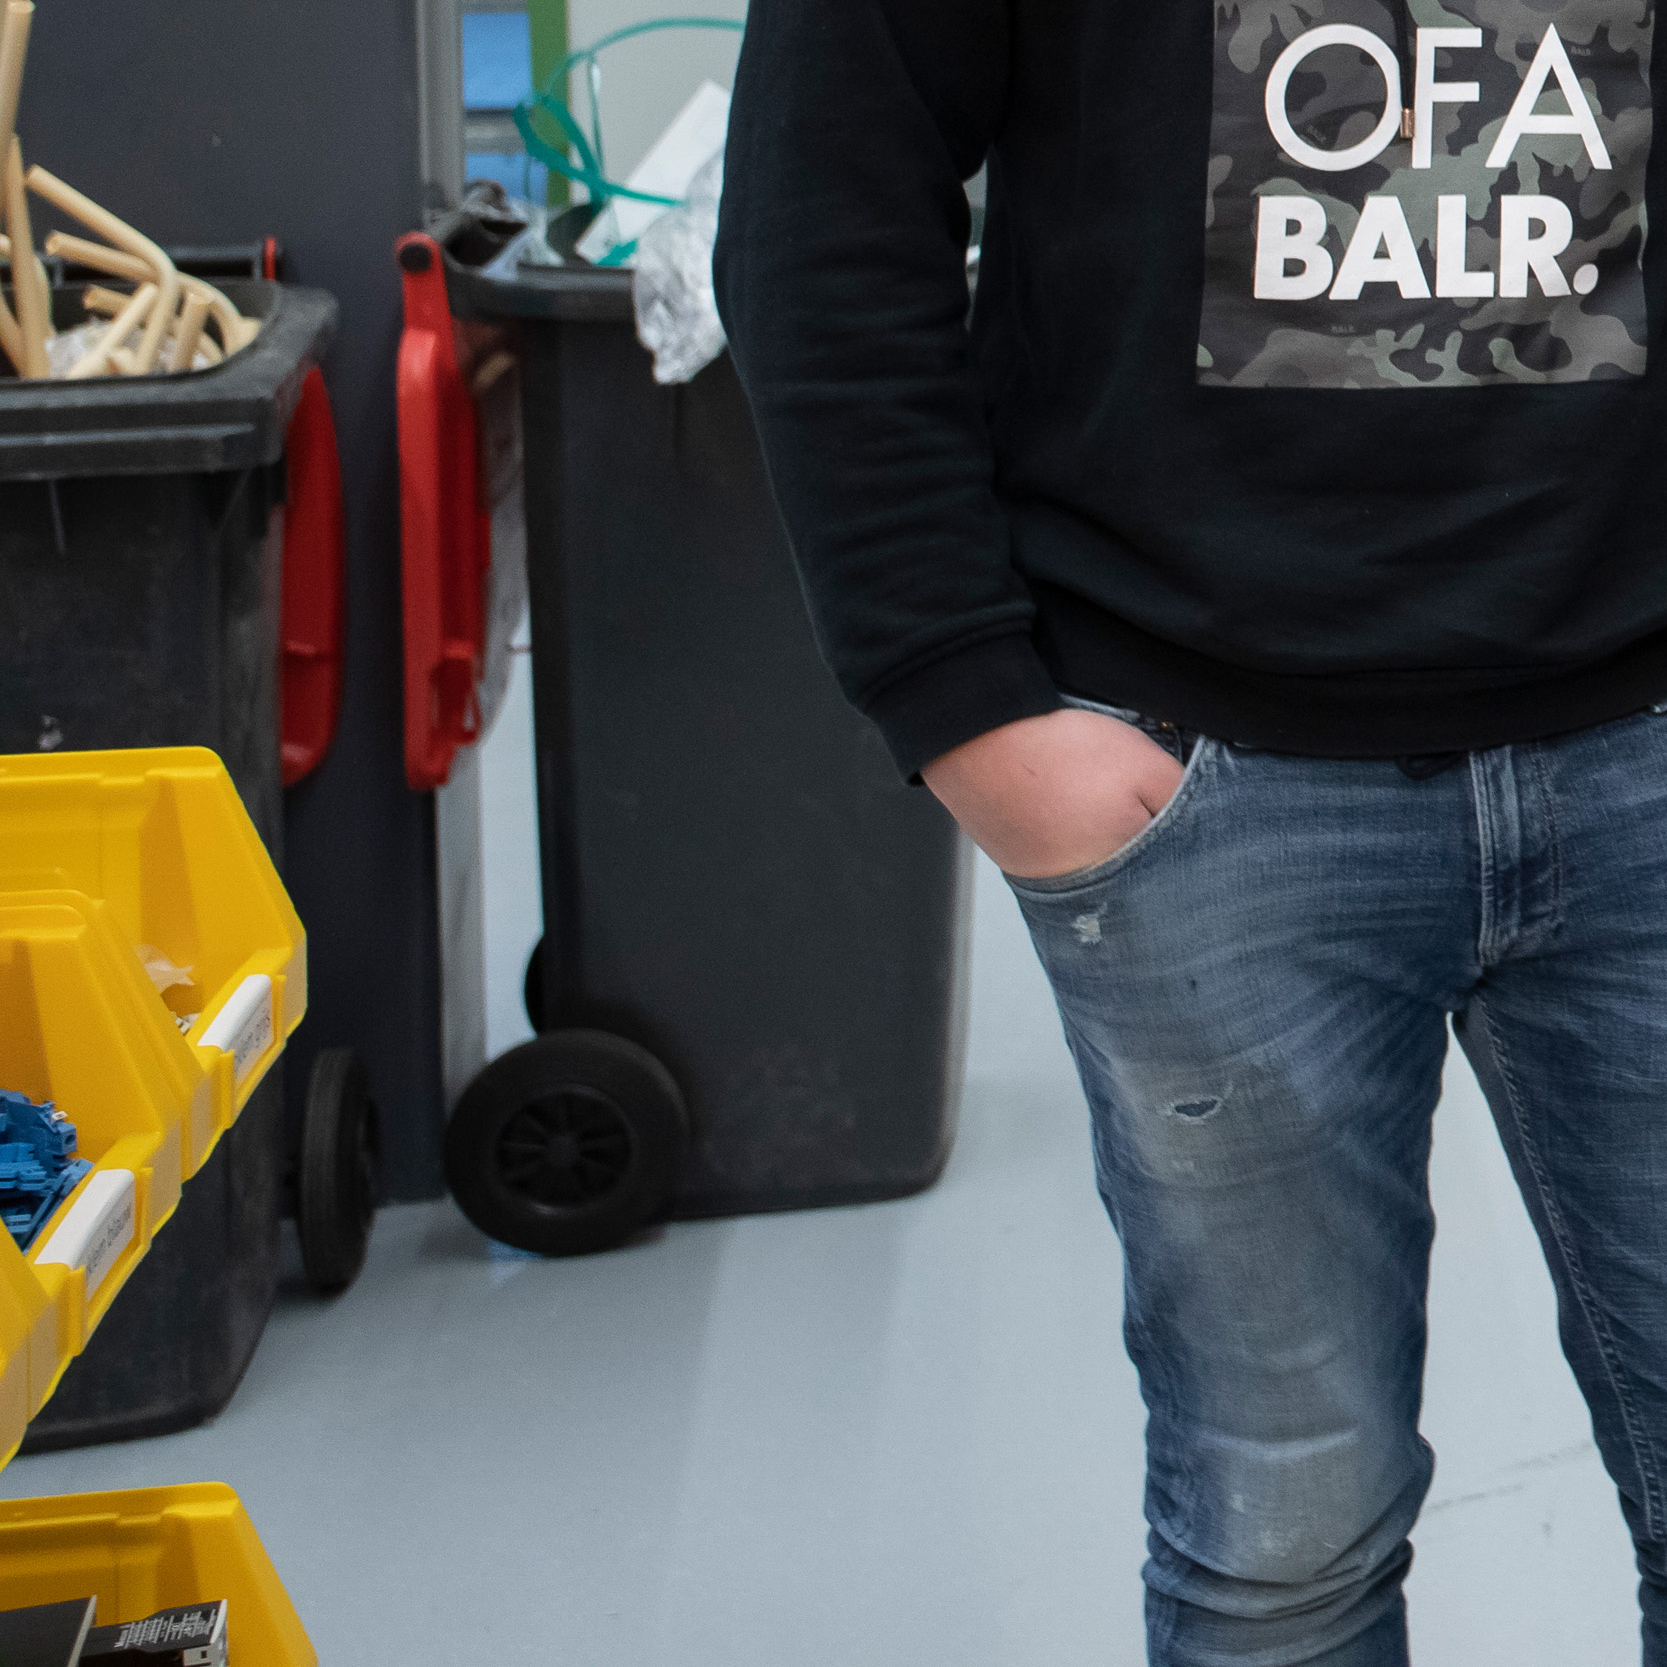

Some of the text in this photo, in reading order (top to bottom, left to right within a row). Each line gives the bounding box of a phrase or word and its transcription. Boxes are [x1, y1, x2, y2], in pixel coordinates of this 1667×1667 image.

[1265, 22, 1613, 171] OF A
[1253, 194, 1599, 300] BALR.
